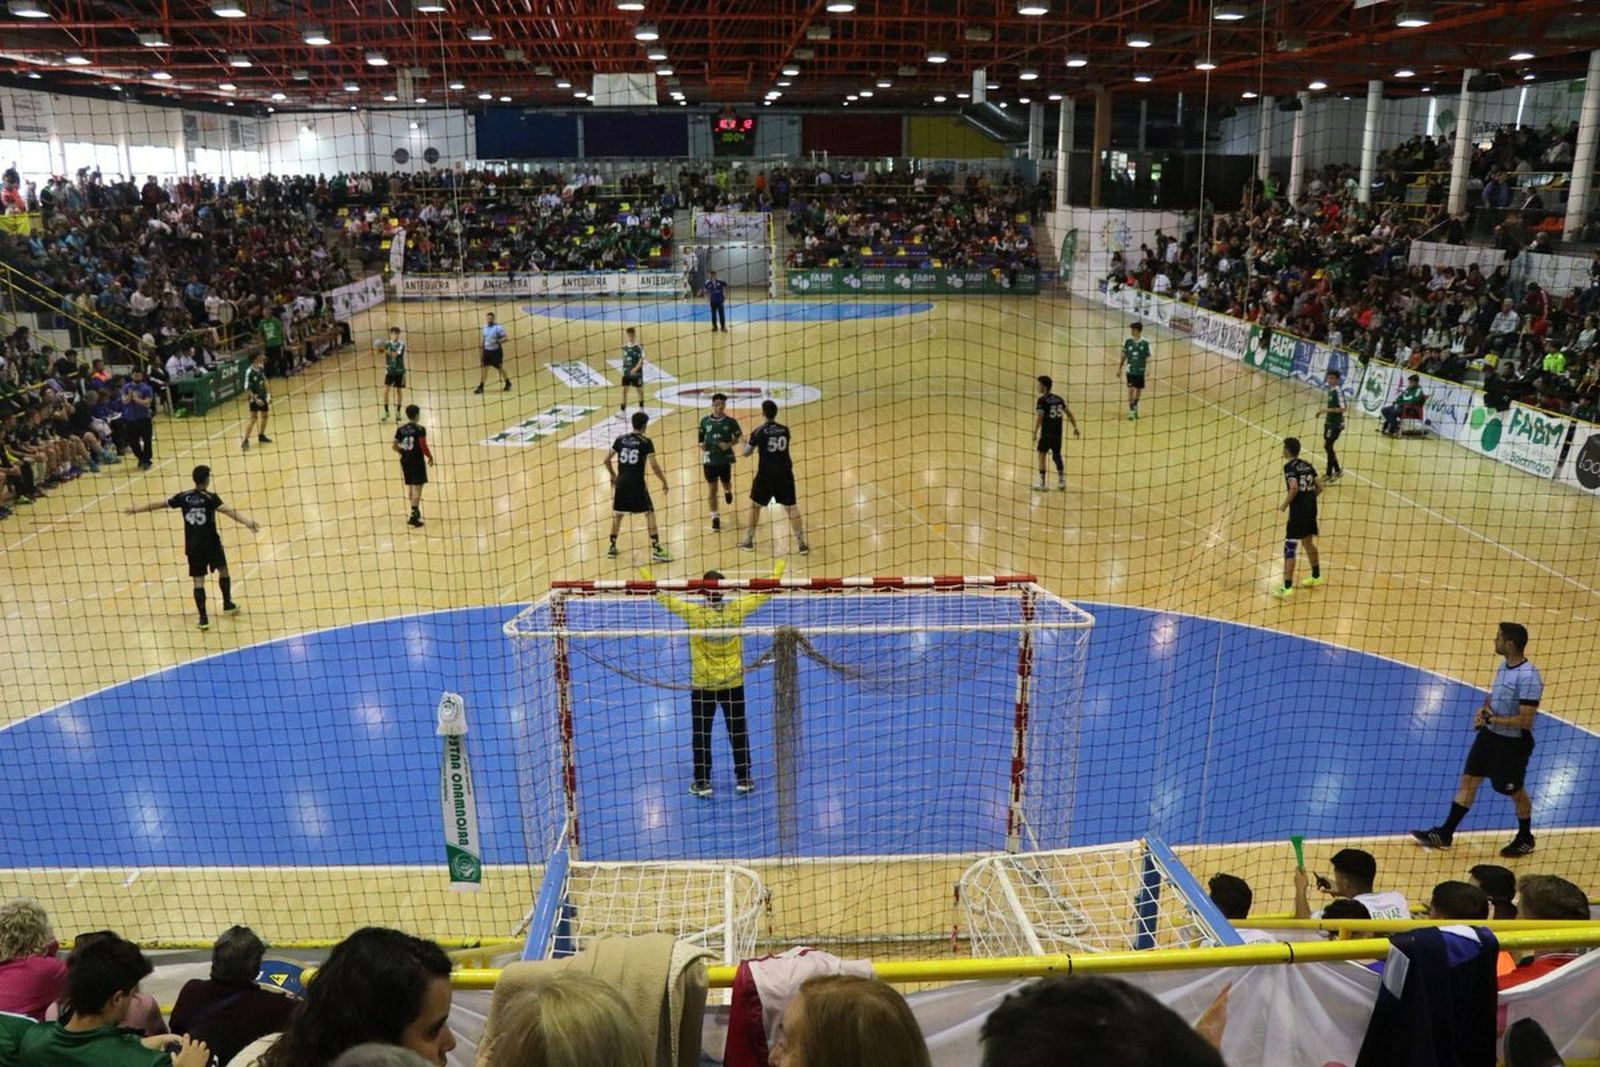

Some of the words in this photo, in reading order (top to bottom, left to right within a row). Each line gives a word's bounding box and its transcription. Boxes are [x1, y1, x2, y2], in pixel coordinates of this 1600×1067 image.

[405, 281, 449, 290] ANTEQUERA
[483, 279, 528, 288] ANTEQUERA
[562, 277, 607, 287] ANTEQUERA
[1269, 332, 1297, 359] FABM
[1508, 407, 1564, 449] FABM
[767, 436, 787, 453] 50
[619, 447, 640, 465] 56
[185, 507, 207, 526] 45
